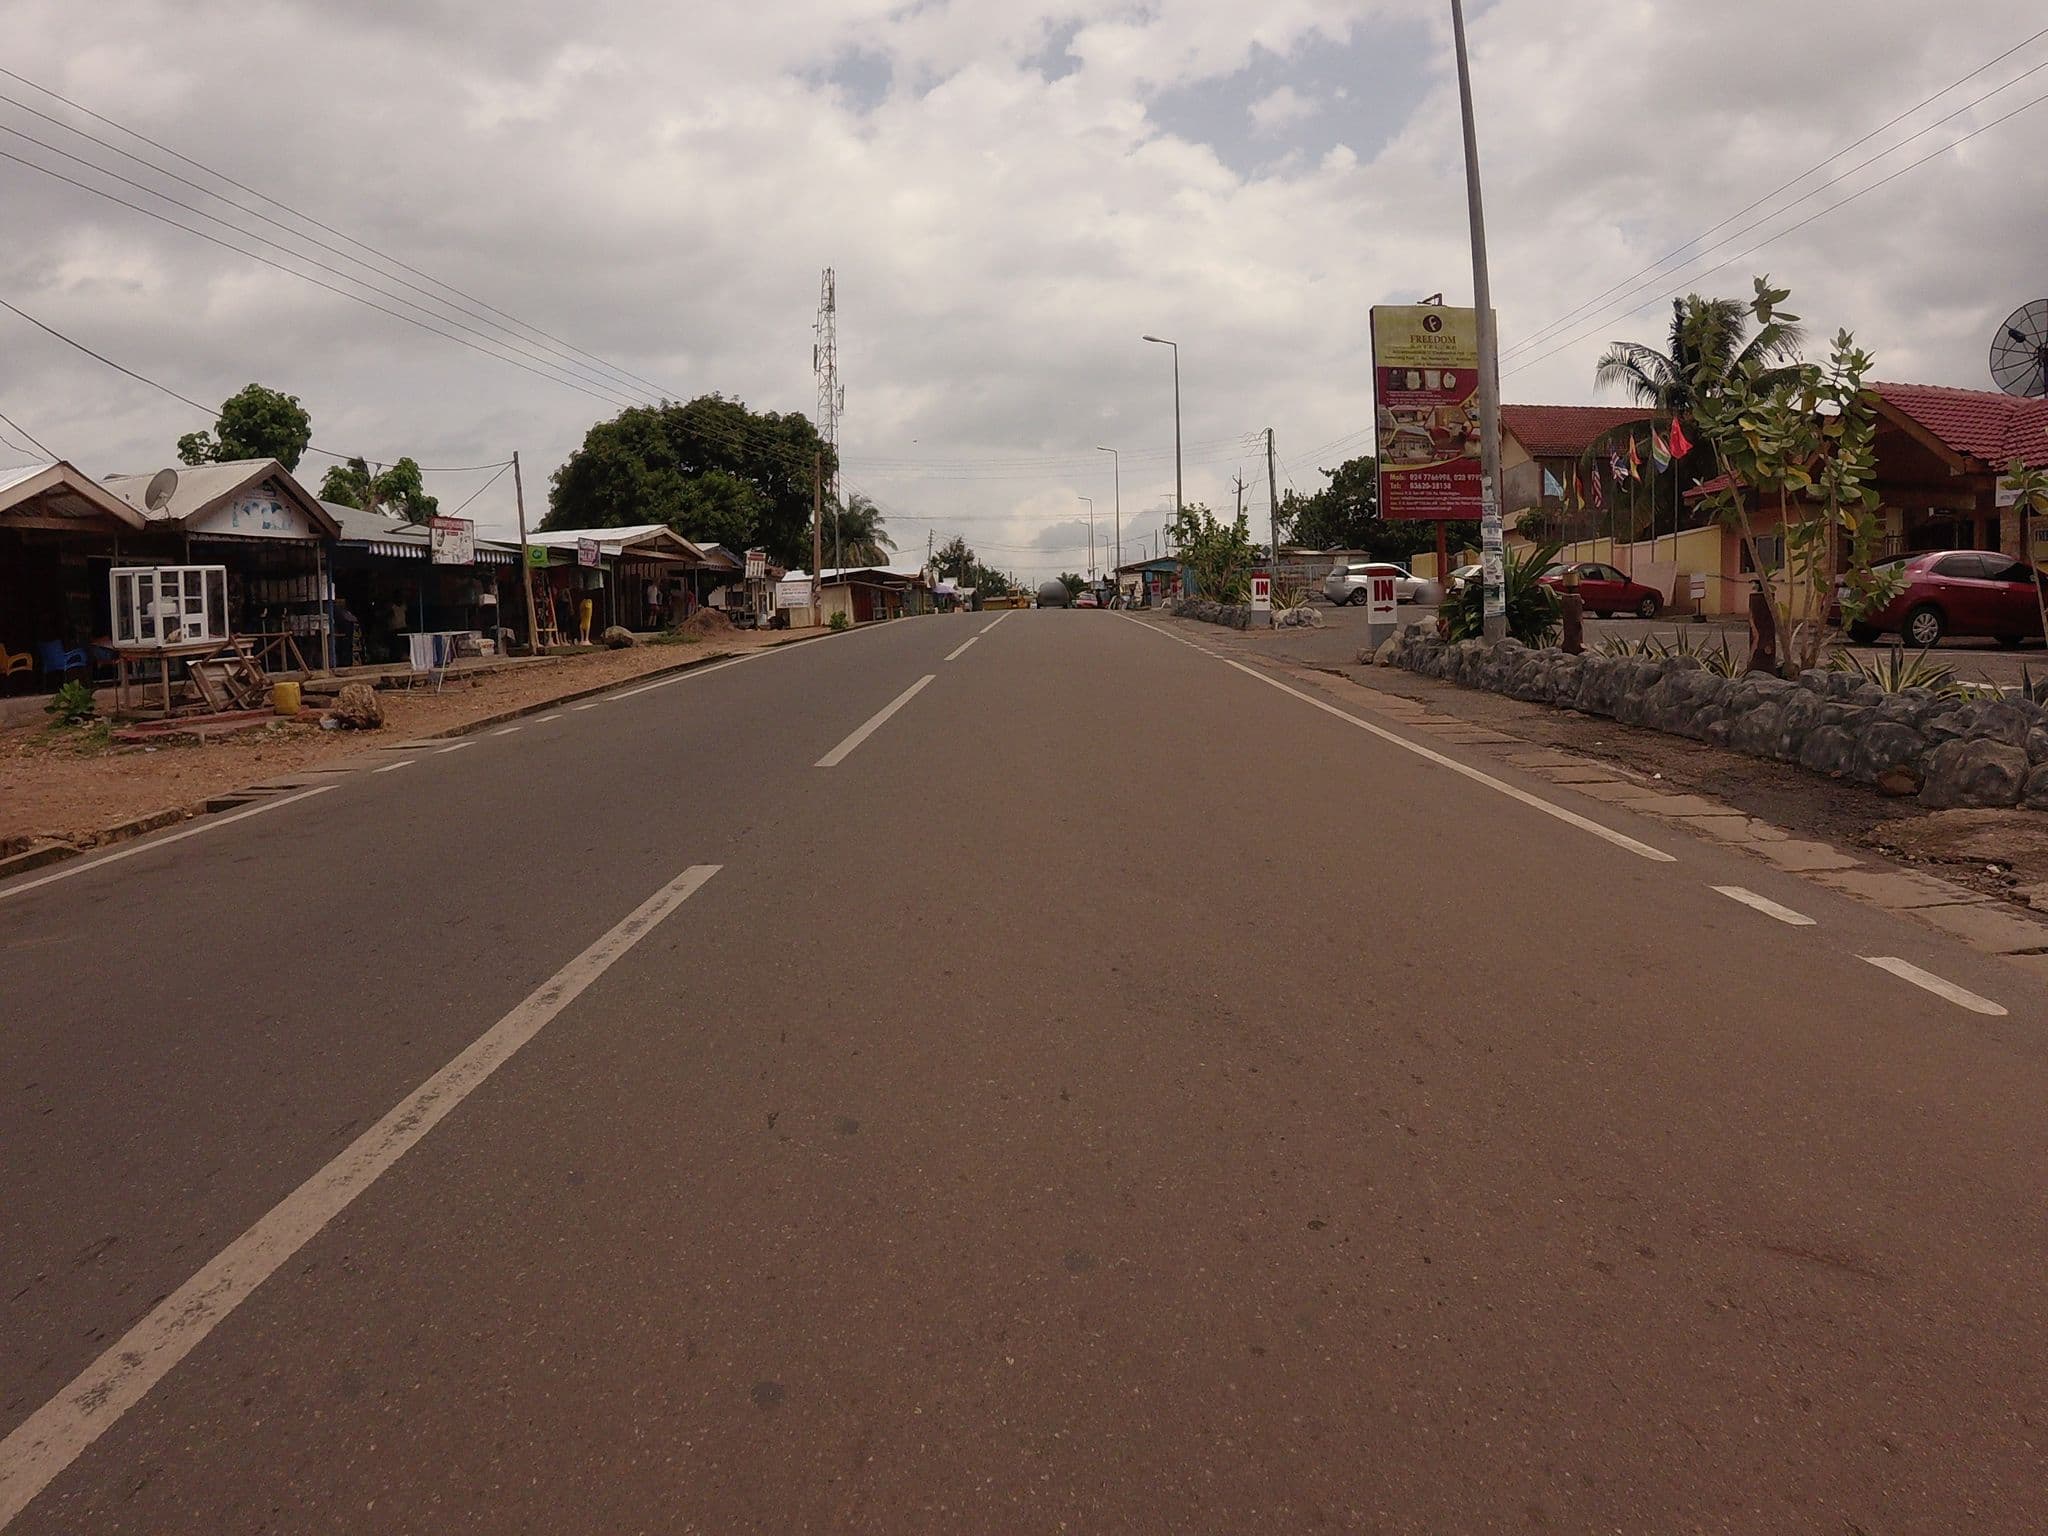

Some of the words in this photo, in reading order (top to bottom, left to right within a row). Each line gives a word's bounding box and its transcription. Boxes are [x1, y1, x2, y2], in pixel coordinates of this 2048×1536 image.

[1410, 335, 1456, 344] FREEDOM
[1255, 581, 1269, 596] IN
[1373, 580, 1394, 602] IN
